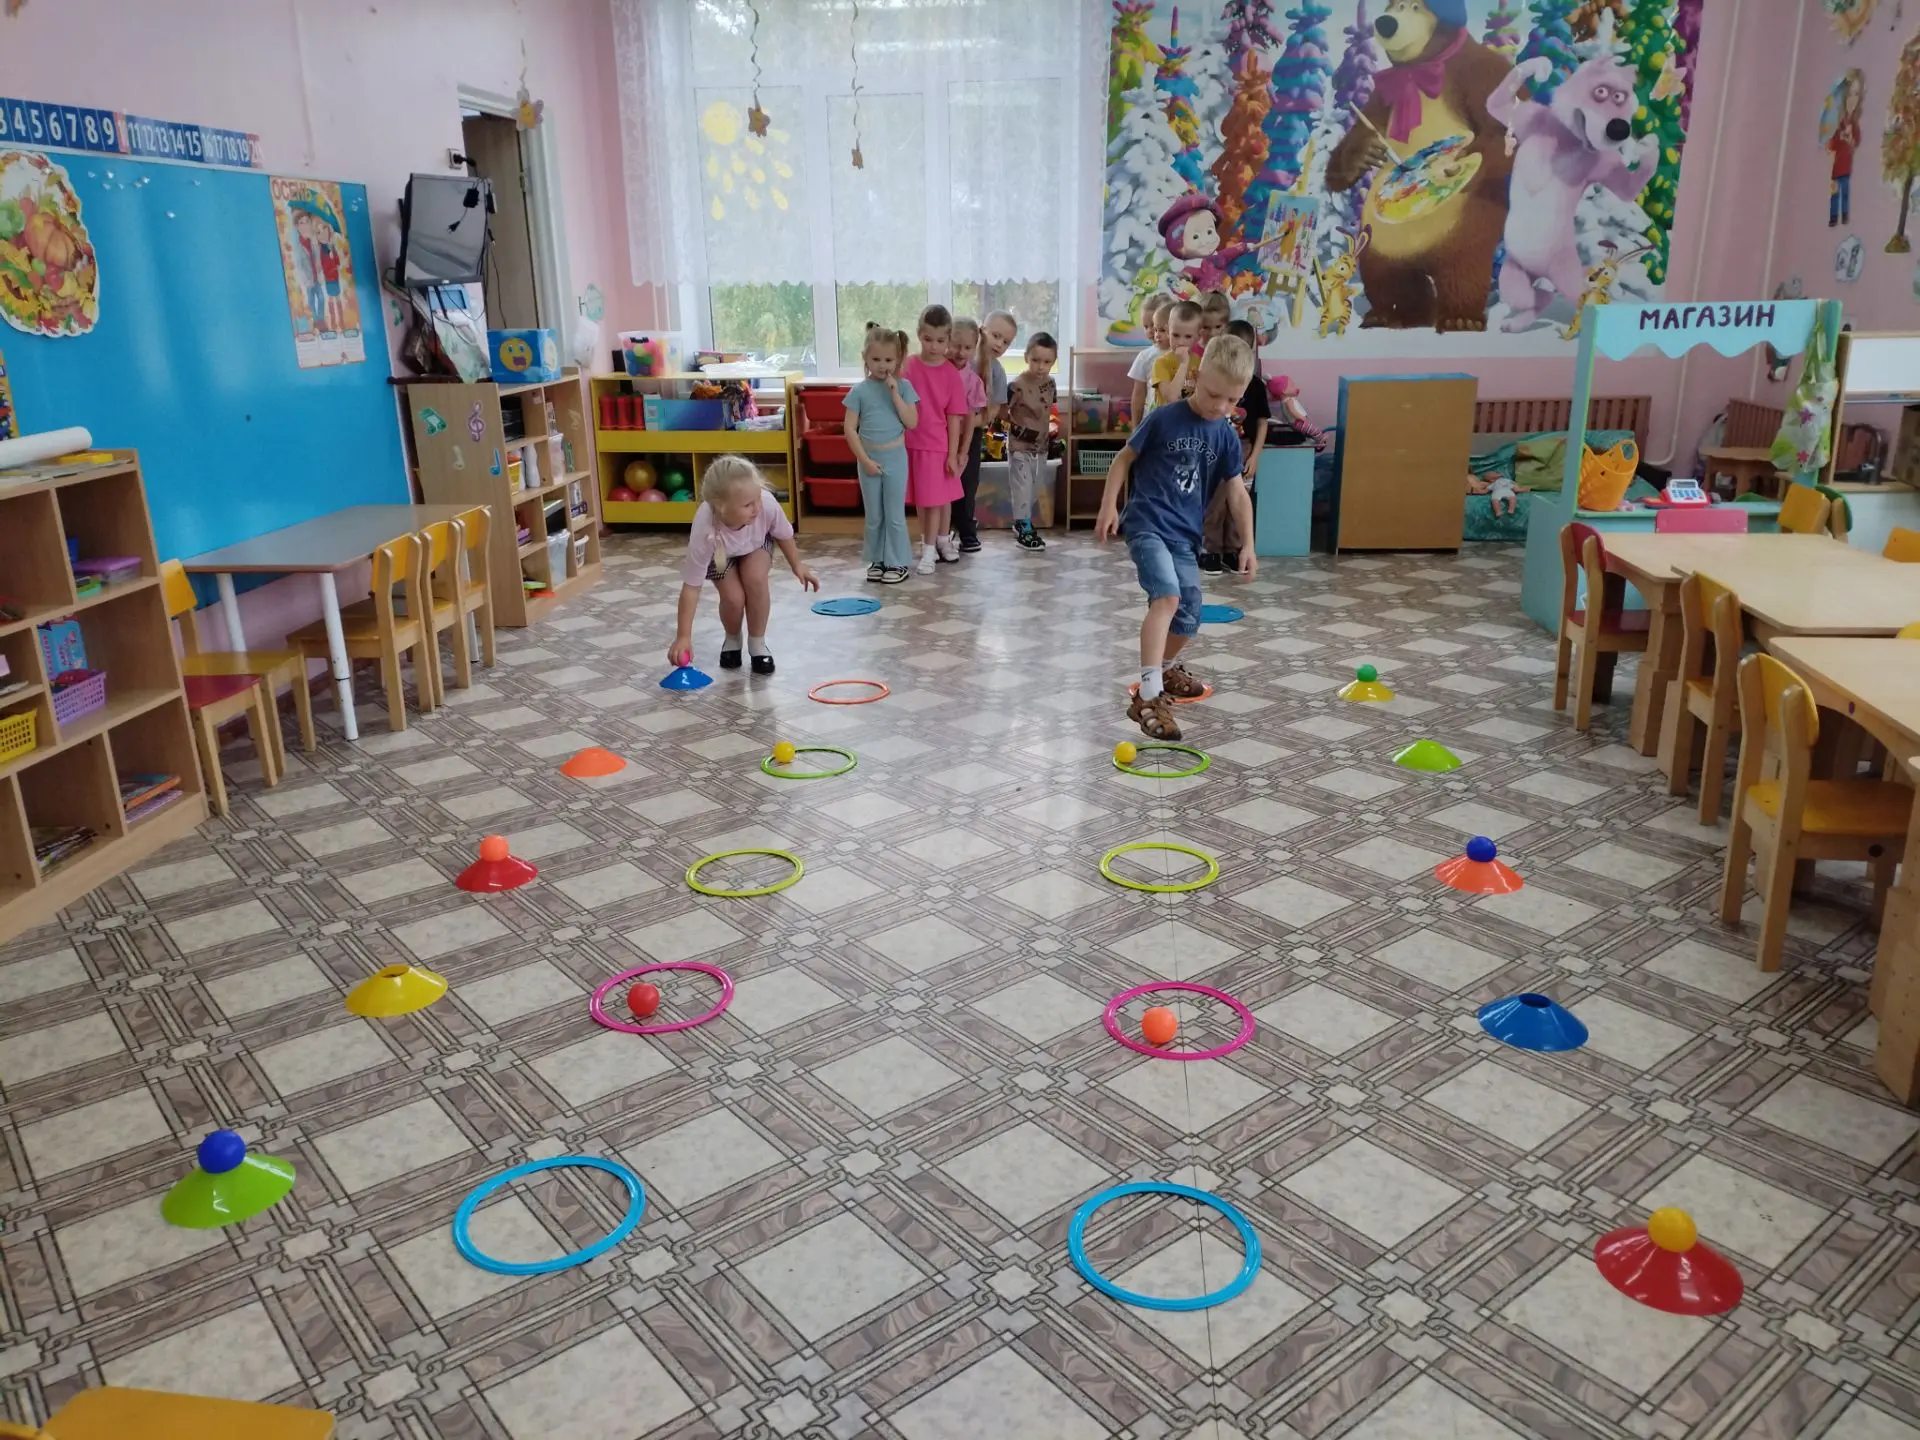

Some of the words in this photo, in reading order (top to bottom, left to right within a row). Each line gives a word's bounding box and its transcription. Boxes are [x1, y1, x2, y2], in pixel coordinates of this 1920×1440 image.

[15, 107, 26, 136] 4
[30, 108, 43, 139] 5
[49, 111, 62, 141] 6
[65, 113, 77, 142] 7
[84, 115, 99, 144] 8
[102, 116, 114, 145] 9
[128, 122, 142, 149] 11
[142, 124, 156, 151] 12
[155, 126, 169, 153] 13
[168, 129, 185, 155] 14
[185, 130, 202, 156] 15
[203, 133, 213, 157] 16
[212, 135, 223, 159] 17
[224, 136, 238, 160] 18
[237, 138, 250, 162] 19
[271, 179, 312, 202] ОСЕНЬ
[1640, 304, 1775, 330] МАГАЗИН
